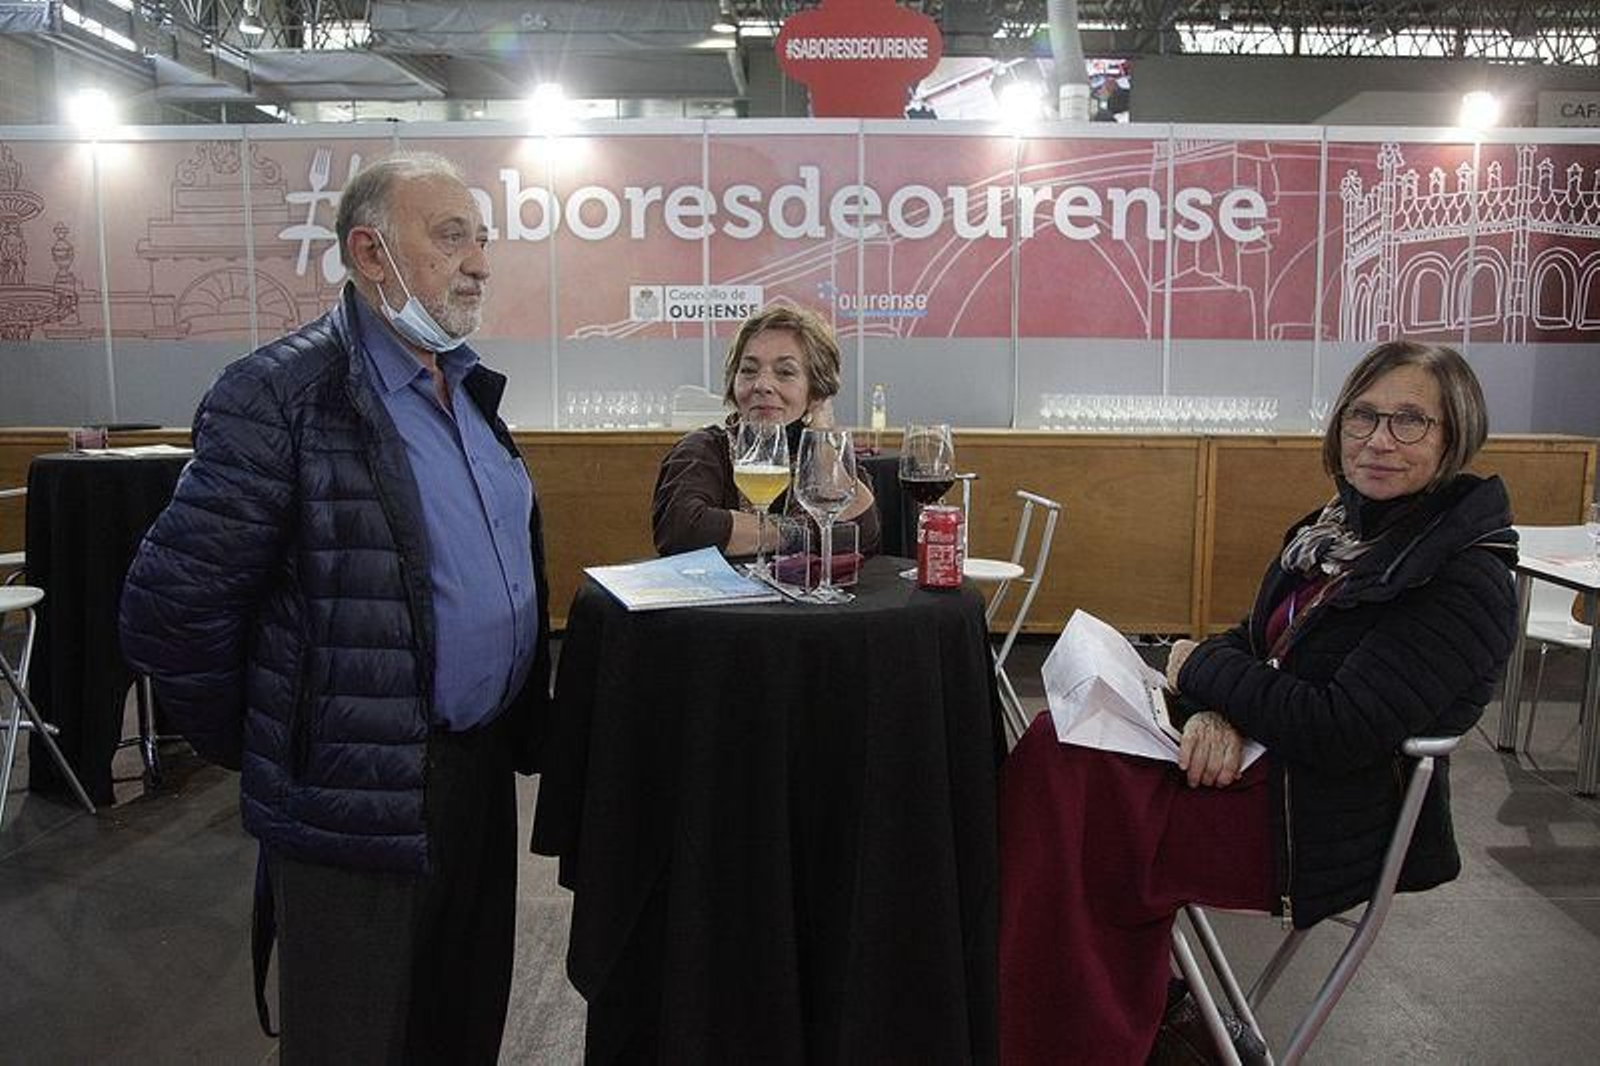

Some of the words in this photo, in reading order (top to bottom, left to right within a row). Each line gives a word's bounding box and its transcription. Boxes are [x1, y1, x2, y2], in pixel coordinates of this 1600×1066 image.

[785, 37, 928, 59] #SABORESDEOURENSE
[1561, 103, 1600, 119] CAF
[731, 287, 747, 301] de
